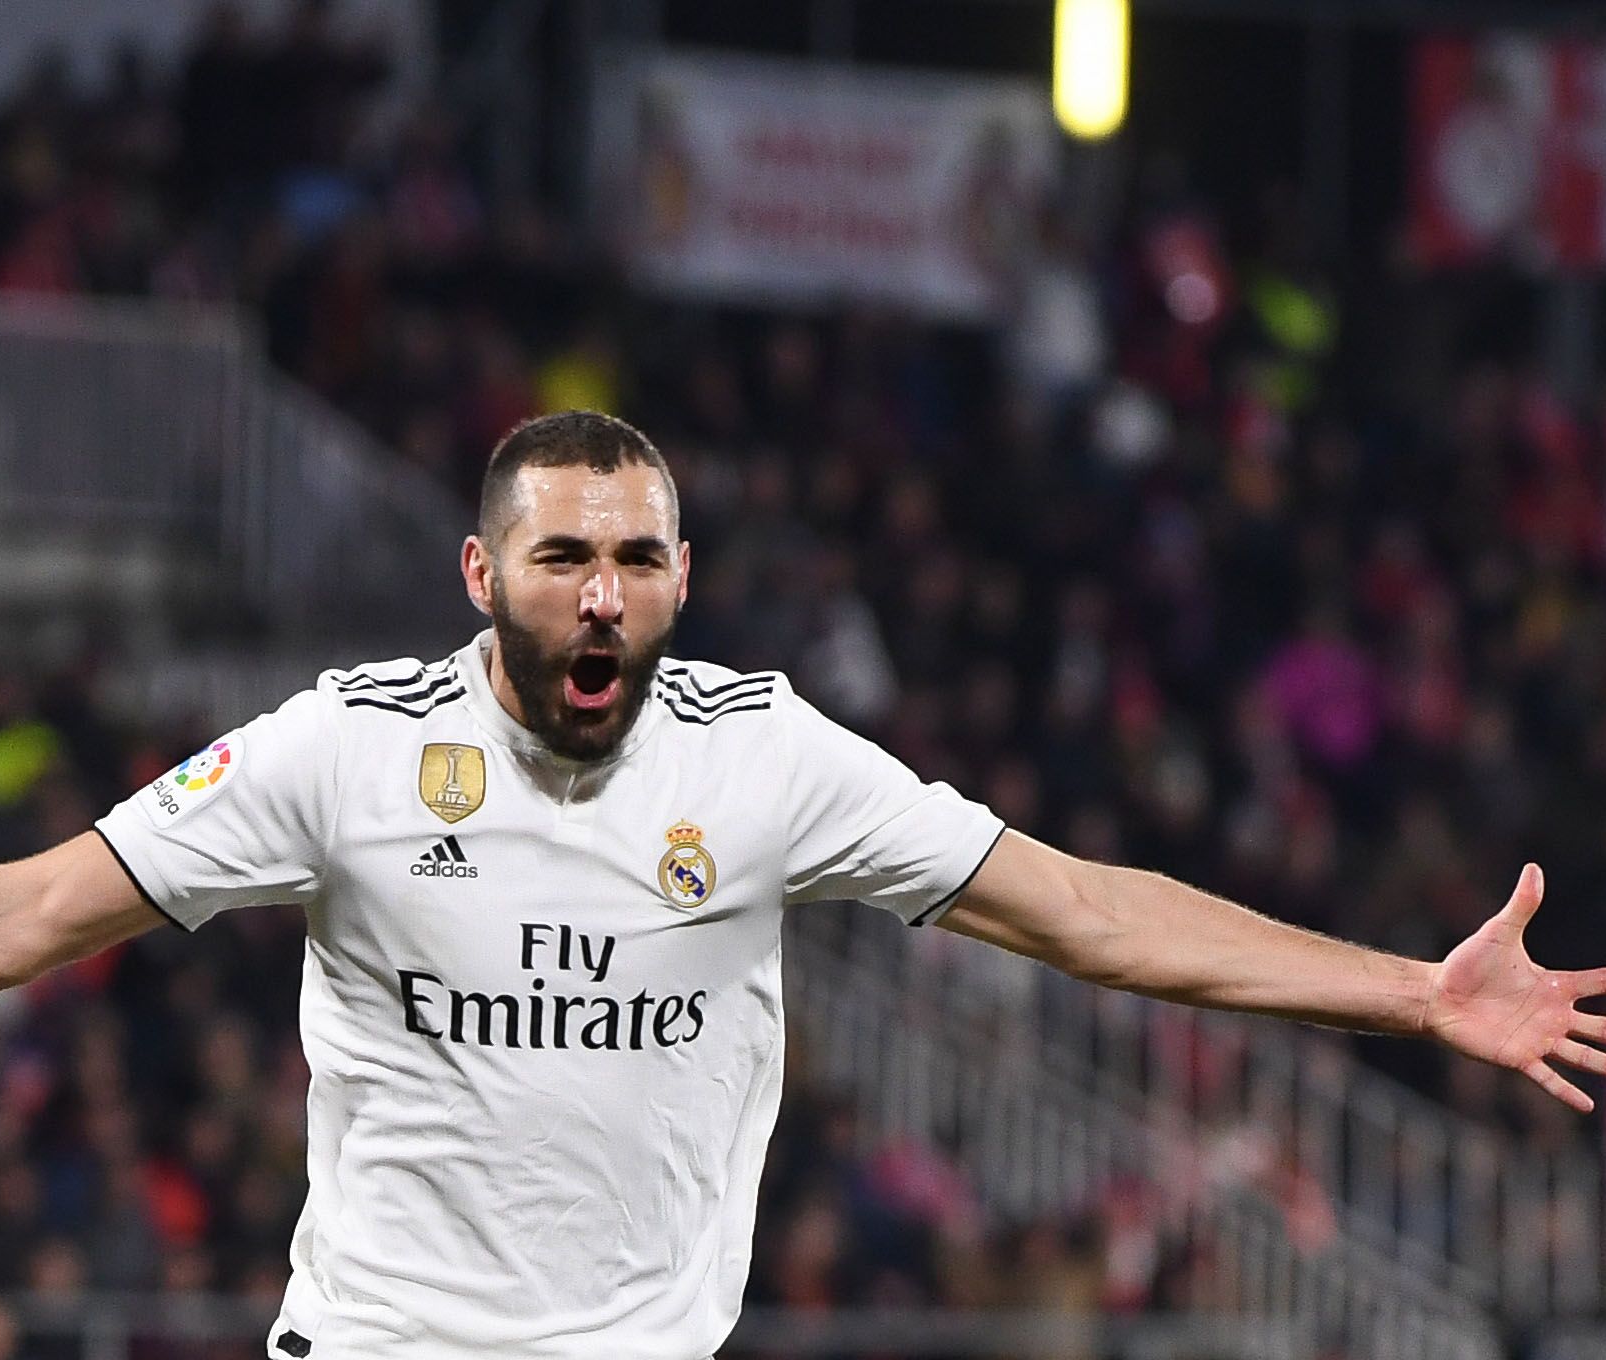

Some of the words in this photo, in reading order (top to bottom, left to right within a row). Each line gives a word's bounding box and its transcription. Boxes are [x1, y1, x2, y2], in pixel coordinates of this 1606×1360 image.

[410, 861, 478, 878] adidas
[520, 922, 616, 982] Fly
[396, 969, 707, 1051] Emirates
